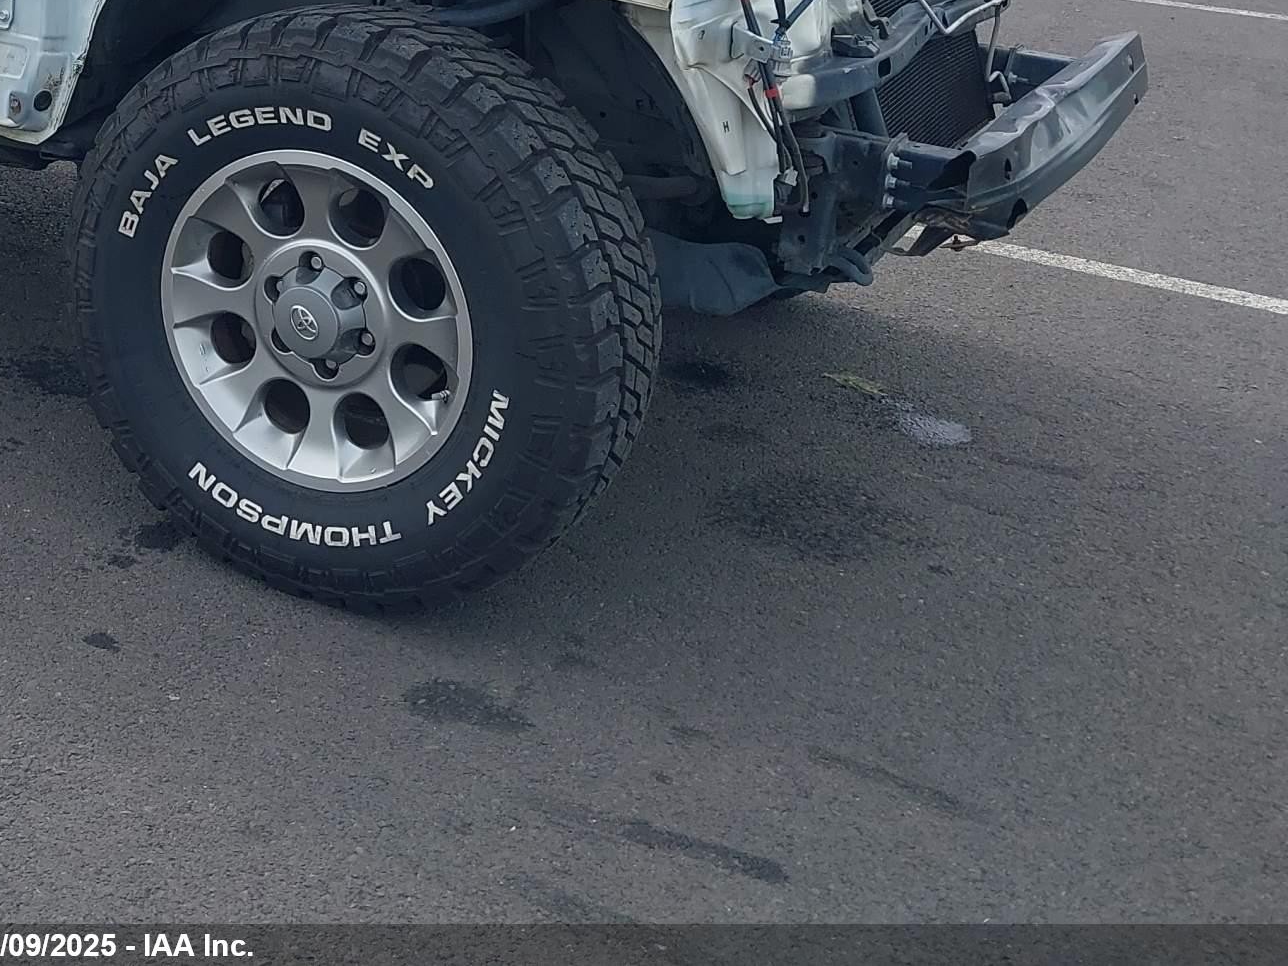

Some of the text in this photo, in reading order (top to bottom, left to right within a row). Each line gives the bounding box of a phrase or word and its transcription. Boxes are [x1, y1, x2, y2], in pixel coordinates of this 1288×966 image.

[118, 106, 434, 238] BAJA LEGEND EXP
[188, 389, 510, 547] MICKEY THOMPSON
